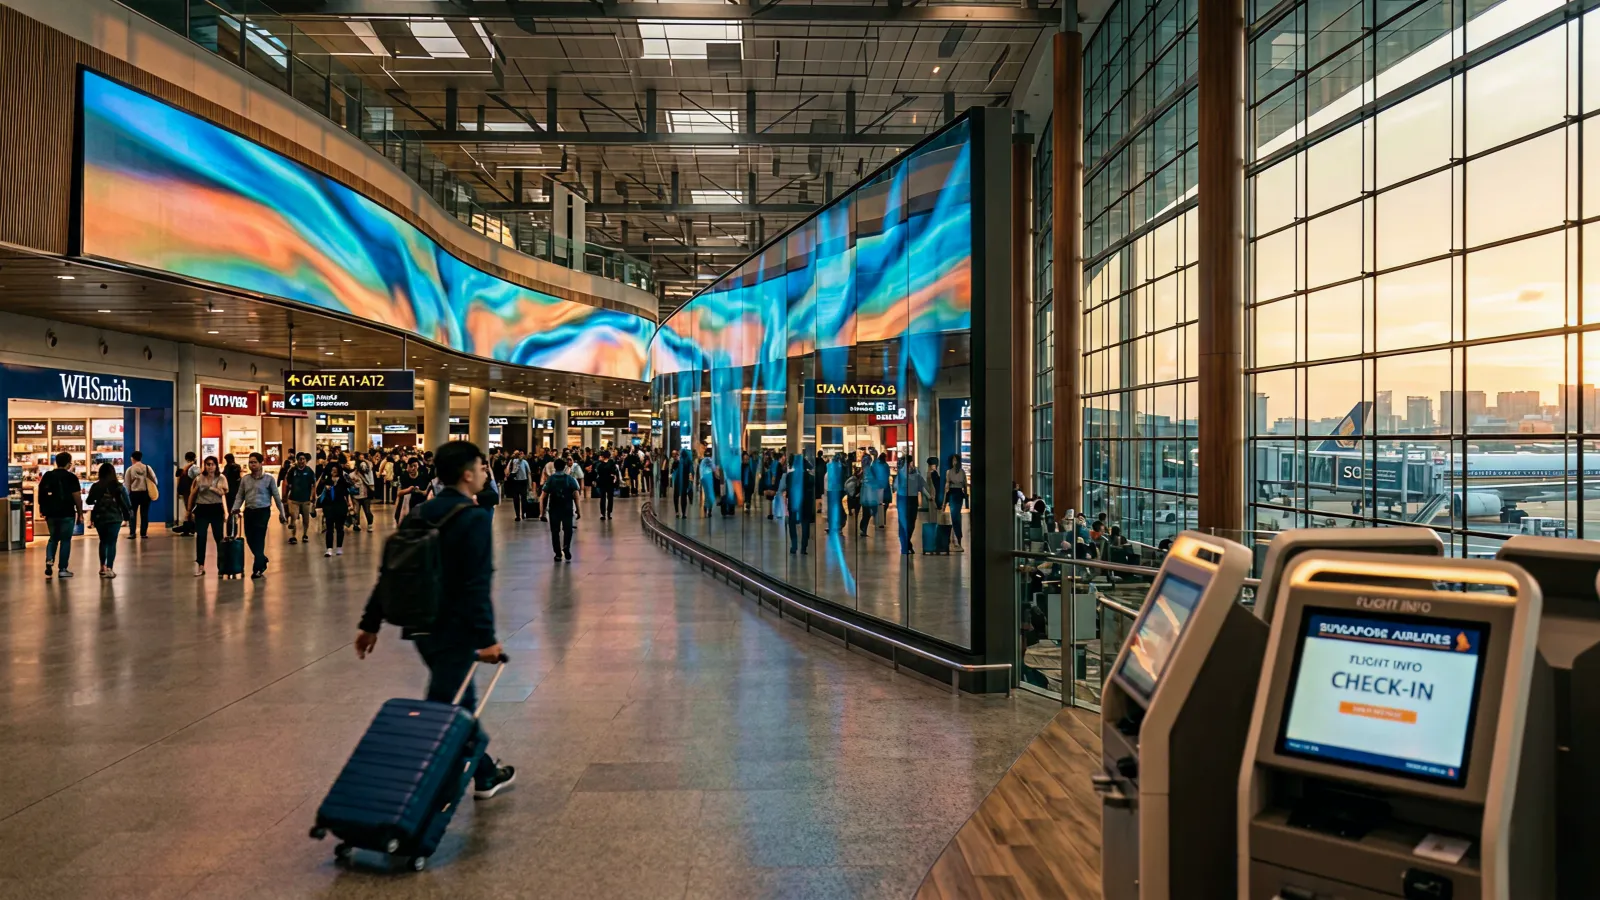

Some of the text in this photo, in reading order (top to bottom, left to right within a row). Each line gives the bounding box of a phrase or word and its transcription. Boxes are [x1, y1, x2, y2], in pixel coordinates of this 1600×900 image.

[59, 373, 132, 402] WHSmith
[302, 374, 337, 387] GATE
[1331, 671, 1434, 700] CHECK-IN
